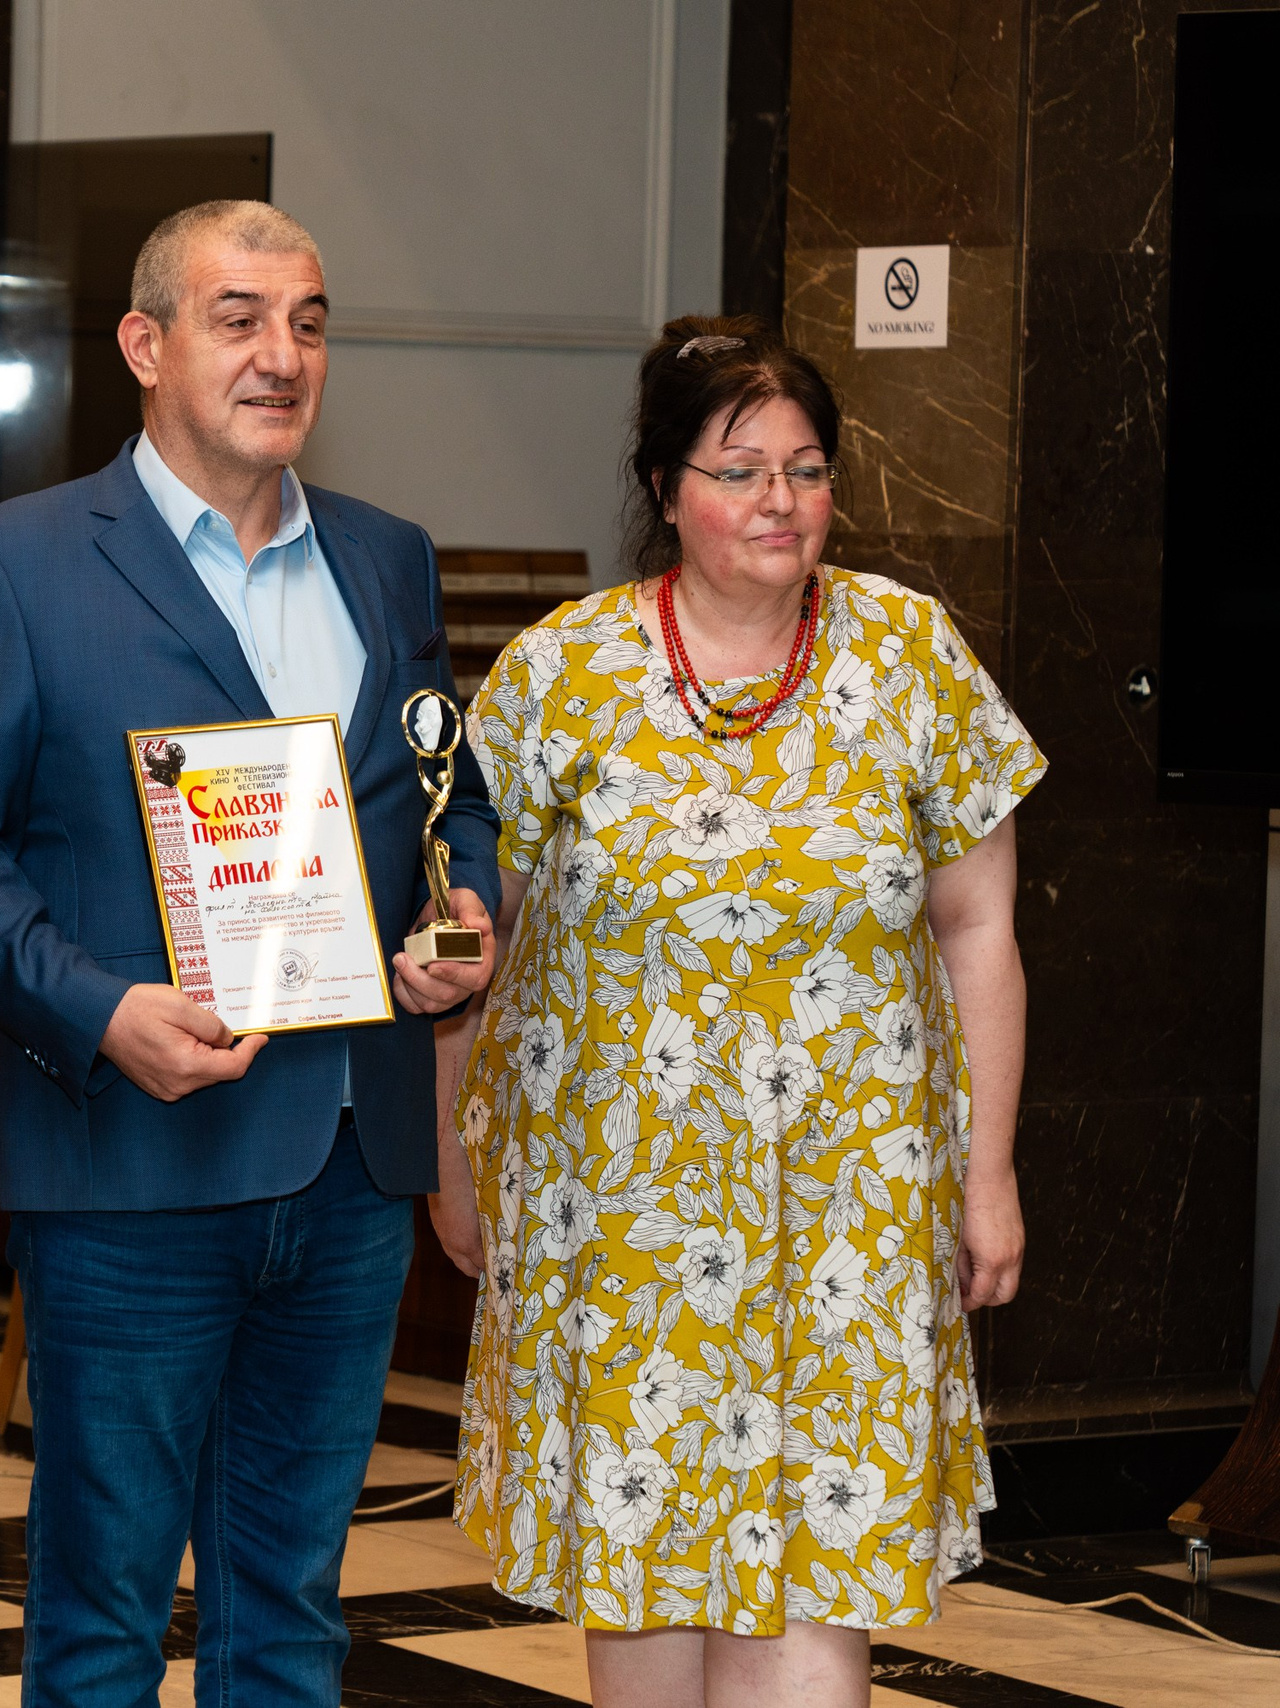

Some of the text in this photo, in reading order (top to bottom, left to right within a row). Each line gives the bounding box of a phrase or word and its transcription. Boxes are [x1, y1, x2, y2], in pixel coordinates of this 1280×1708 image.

[867, 320, 883, 334] NO
[210, 777, 229, 785] КИНО
[243, 771, 292, 782] ТЕЛЕВИЗИОН
[215, 768, 230, 776] XIV
[237, 781, 276, 790] ФЕСТИВАЛ
[192, 818, 286, 846] Приказк
[228, 918, 250, 926] принос
[258, 914, 295, 924] развитието
[305, 909, 341, 919] филмовото
[305, 917, 346, 927] укрепването
[288, 928, 318, 937] културни
